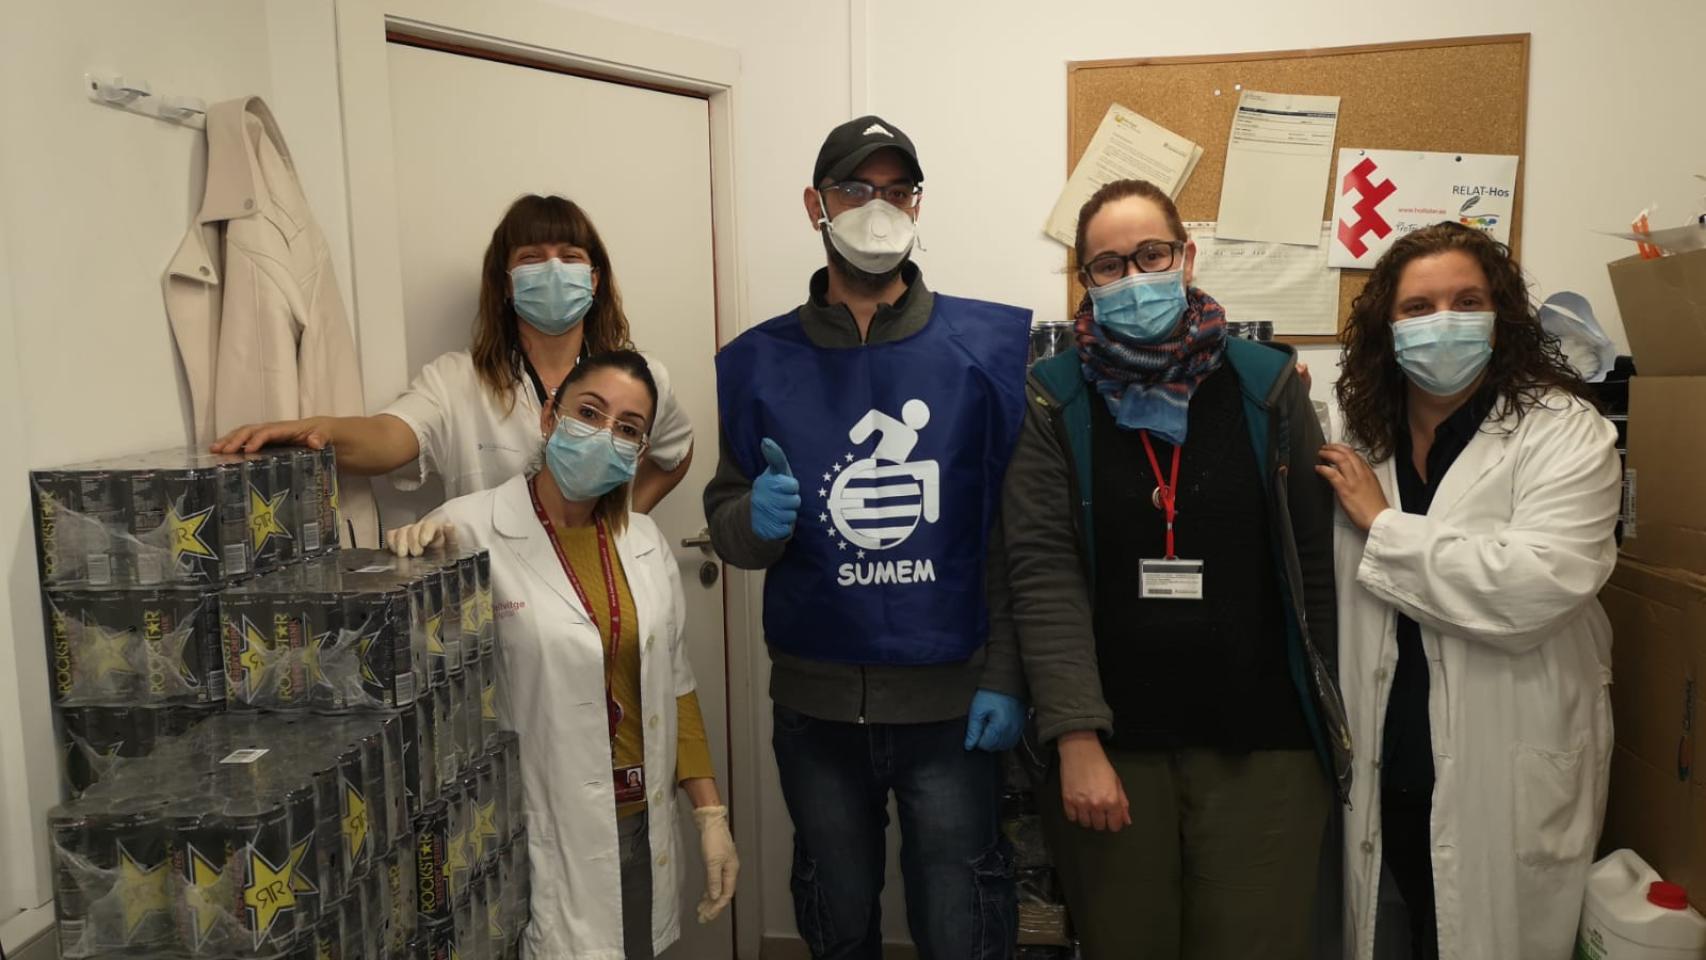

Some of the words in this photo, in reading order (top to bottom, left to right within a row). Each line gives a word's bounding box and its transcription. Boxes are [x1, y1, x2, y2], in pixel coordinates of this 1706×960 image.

[1452, 184, 1510, 198] RELAT-Hos
[837, 558, 936, 587] SUMEM
[418, 832, 436, 913] ROCKSTAR
